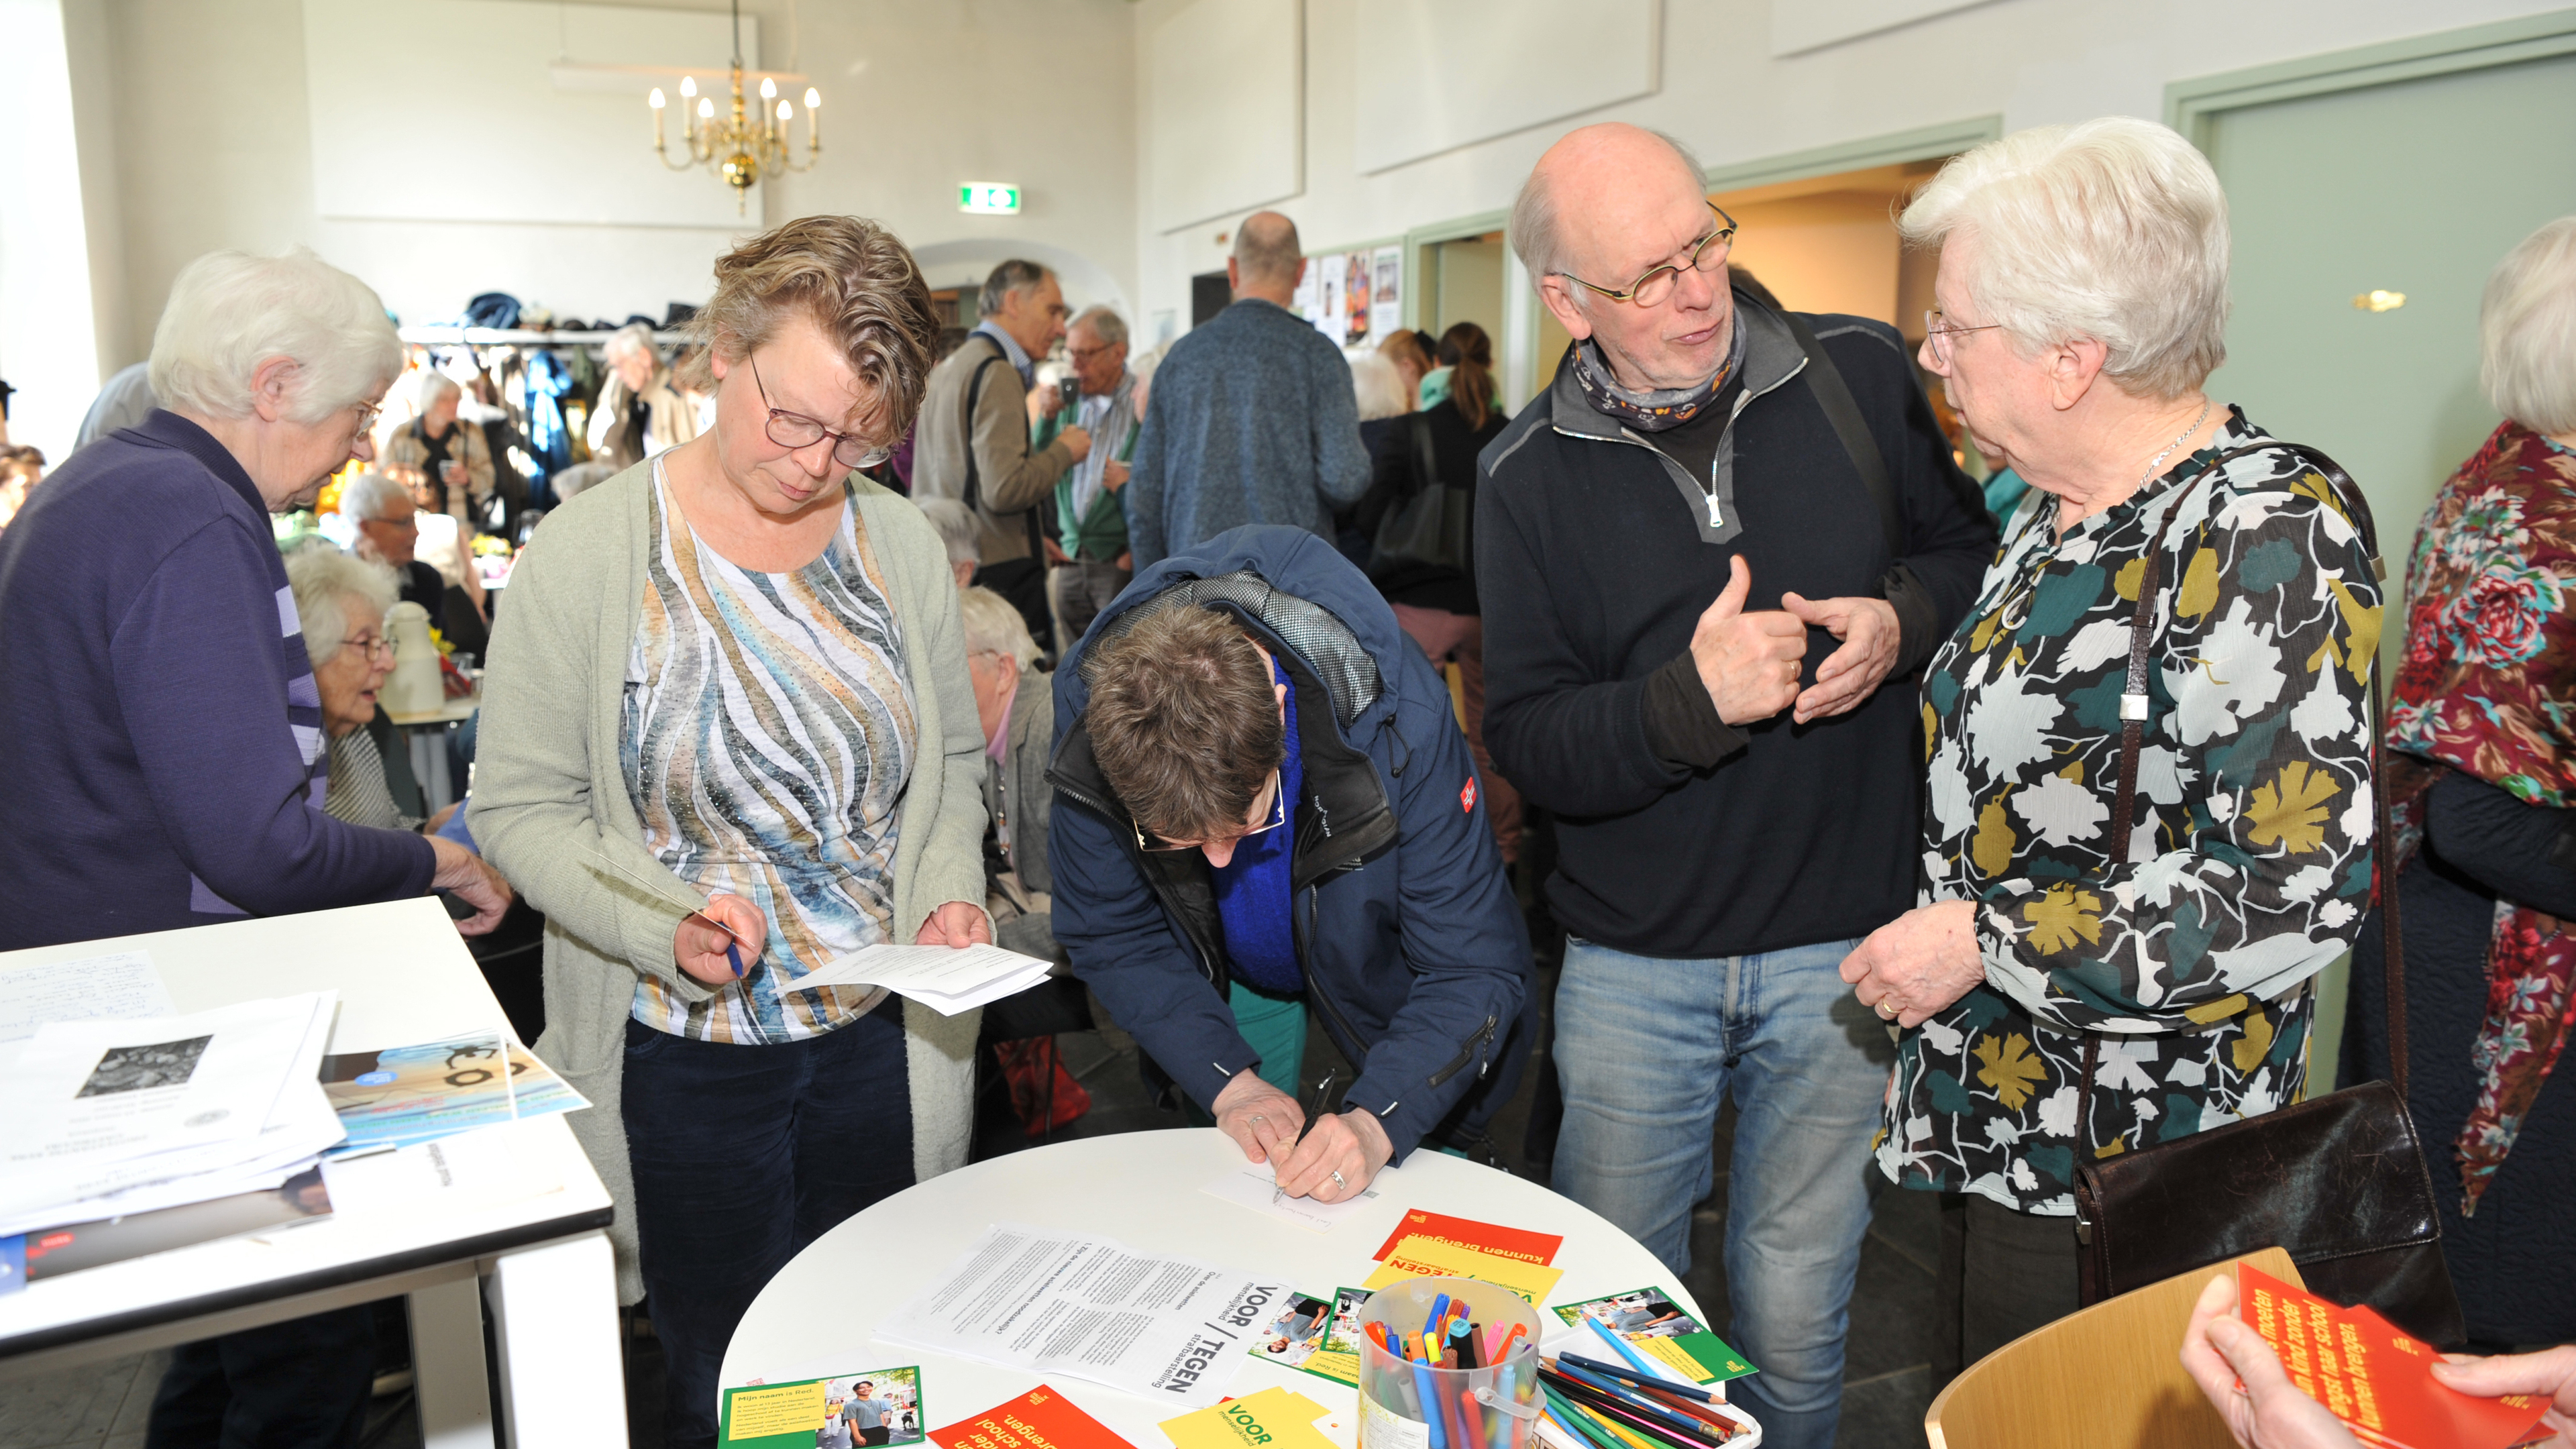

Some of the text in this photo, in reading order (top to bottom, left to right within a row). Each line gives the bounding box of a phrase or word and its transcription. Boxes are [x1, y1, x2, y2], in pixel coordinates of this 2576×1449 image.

[1055, 1260, 1072, 1276] nieuwe
[1077, 1246, 1088, 1256] Zijn
[1395, 1256, 1458, 1273] strafbaarstelling
[1484, 1246, 1544, 1264] kunnen
[1028, 1275, 1055, 1303] asielwetten
[1205, 1272, 1216, 1282] Over
[1175, 1284, 1199, 1311] asielwetten
[1218, 1282, 1254, 1321] menselijkheid
[1228, 1287, 1279, 1327] VOOR
[2252, 1289, 2277, 1340] moeten
[996, 1303, 1029, 1334] noodzakelijk?
[2278, 1298, 2305, 1346] zonder
[1151, 1334, 1201, 1388] strafbaarstelling
[1165, 1340, 1225, 1393] TEGEN
[1316, 1362, 1331, 1370] Red.
[2282, 1340, 2312, 1377] kind
[2302, 1299, 2352, 1418] angst naar school
[2339, 1323, 2367, 1379] brengen.
[2351, 1377, 2382, 1432] kunnen
[975, 1419, 1021, 1448] school
[1218, 1411, 1256, 1446] menselijkheid
[1228, 1404, 1272, 1445] VOOR
